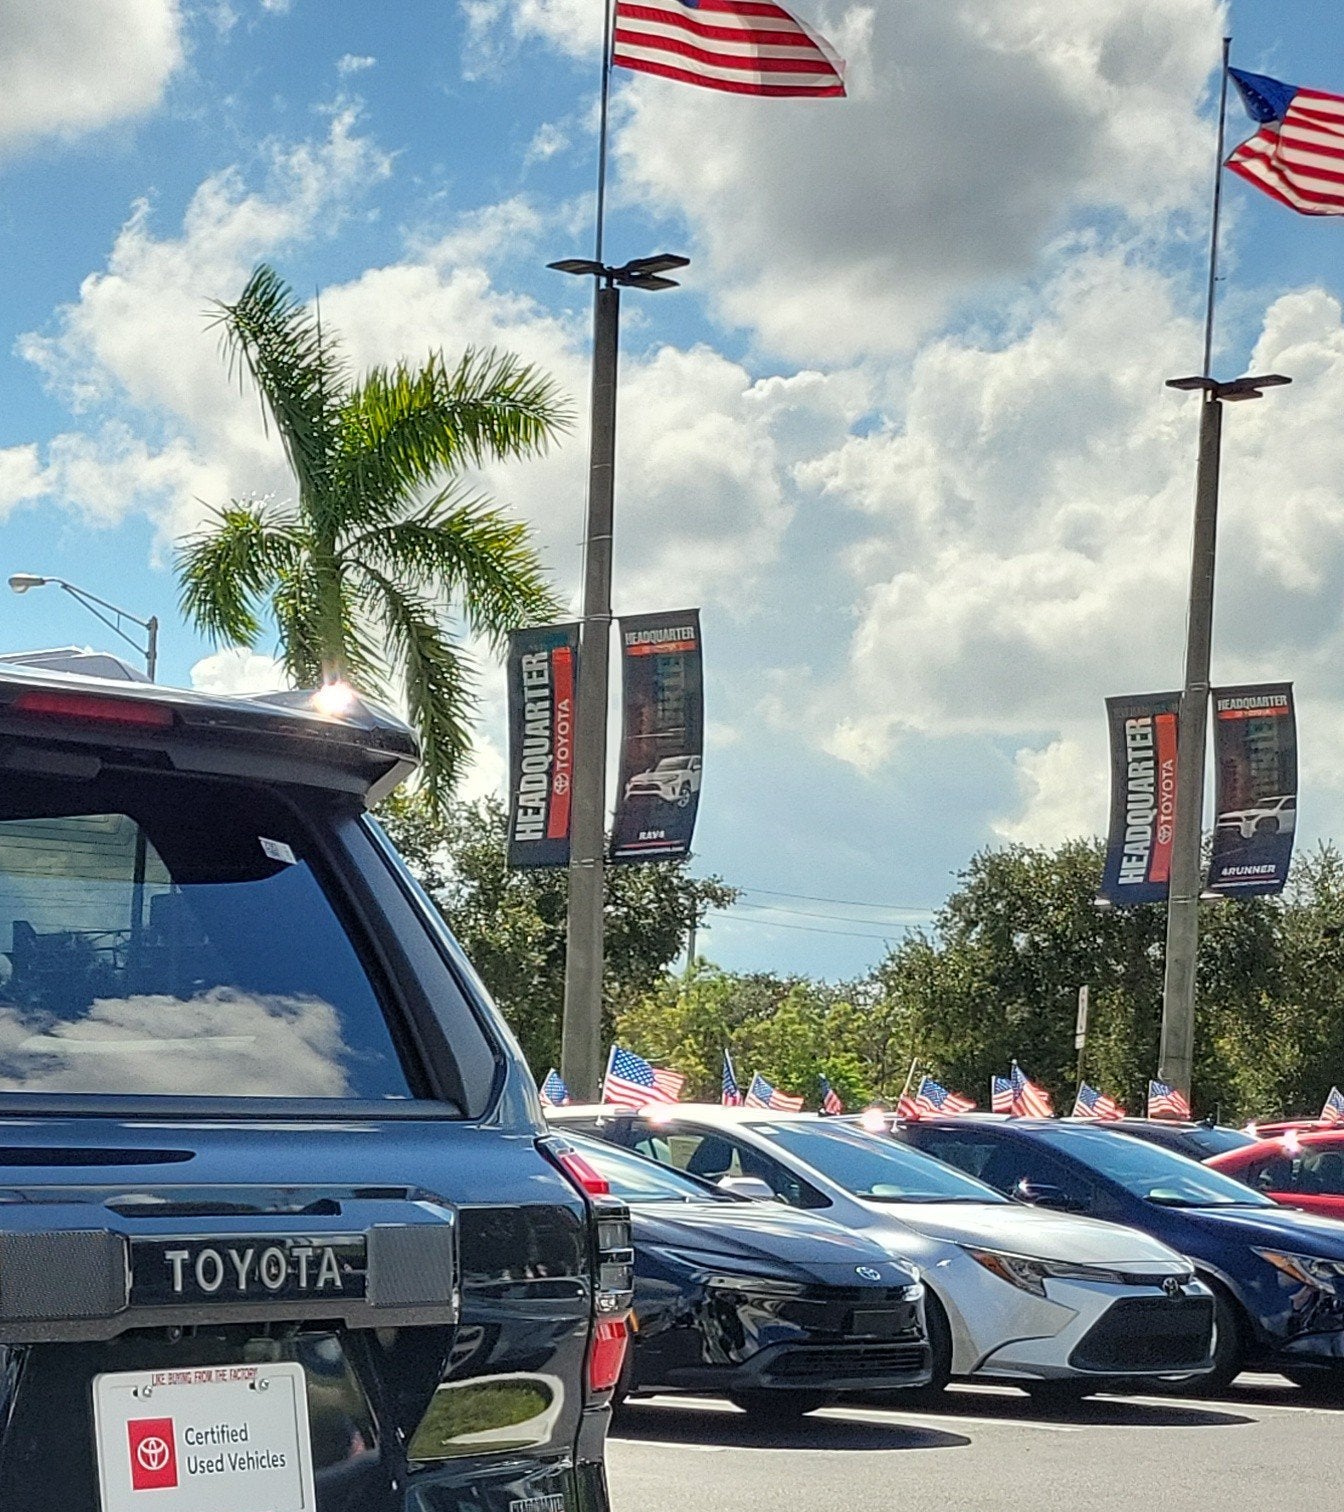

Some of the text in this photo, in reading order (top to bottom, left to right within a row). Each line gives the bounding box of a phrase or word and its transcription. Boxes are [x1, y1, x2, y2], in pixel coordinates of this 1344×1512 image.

[624, 626, 695, 645] HEADQUARTER
[1217, 694, 1288, 711] HEADQUARTER
[515, 650, 548, 842] HEADQUARTER
[556, 698, 570, 770] TOYOTA
[1118, 716, 1155, 885] HEADQUARTER
[1161, 758, 1174, 822] TOYOTA
[1221, 864, 1277, 876] 4RUNNER
[165, 1246, 343, 1292] TOYOTA
[152, 1373, 165, 1387] LIKE
[194, 1370, 213, 1384] FROM
[215, 1369, 228, 1382] THE
[230, 1367, 258, 1381] FACTORY
[185, 1423, 248, 1445] Certified
[187, 1449, 286, 1474] Used Vehicles
